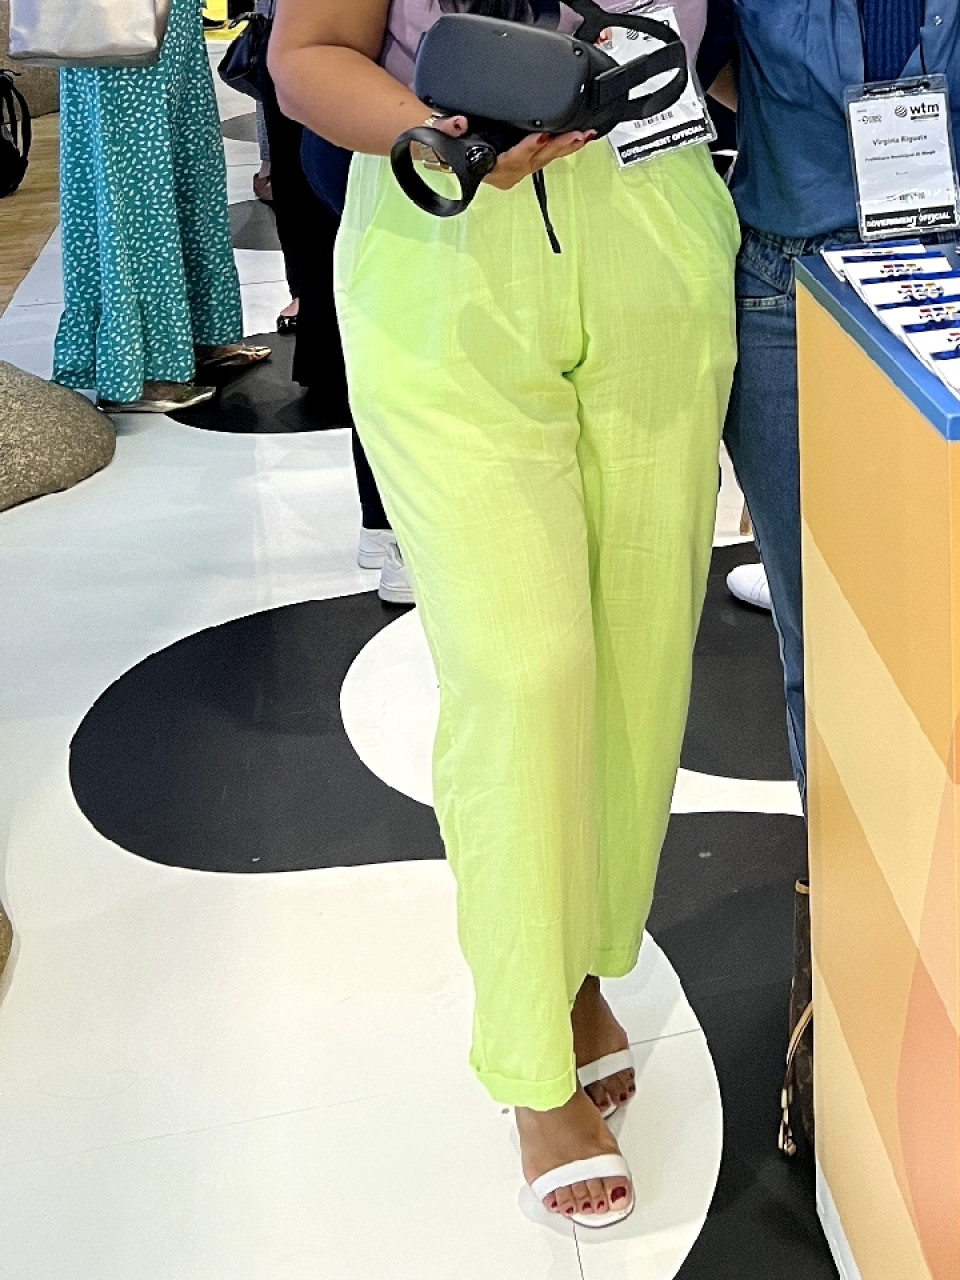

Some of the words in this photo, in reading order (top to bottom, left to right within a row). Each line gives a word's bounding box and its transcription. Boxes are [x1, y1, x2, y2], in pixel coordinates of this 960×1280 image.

[909, 102, 940, 114] wtm
[620, 134, 673, 159] GOVERNMENT
[672, 123, 705, 141] OFFICIAL
